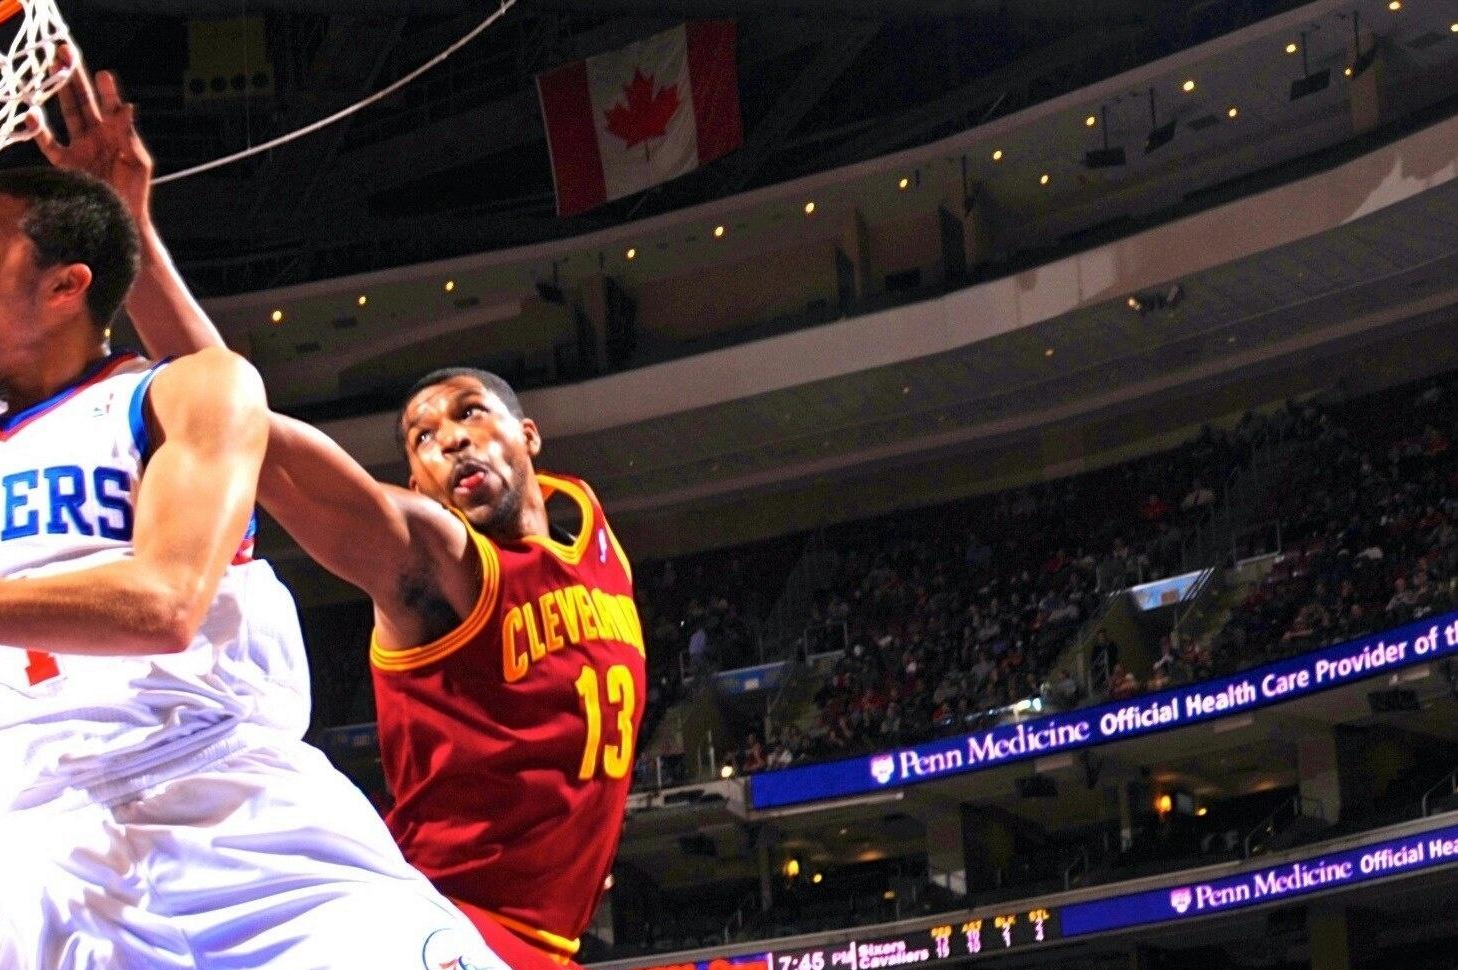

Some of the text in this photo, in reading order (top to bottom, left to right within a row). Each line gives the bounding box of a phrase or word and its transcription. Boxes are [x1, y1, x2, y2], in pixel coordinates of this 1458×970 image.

[575, 664, 636, 781] 13
[900, 749, 963, 779] Penn
[968, 721, 1090, 766] Medicine
[1100, 697, 1180, 737] Official
[1185, 680, 1257, 718] Health
[1262, 669, 1310, 698] Care
[1315, 641, 1408, 684] Provider
[1414, 625, 1440, 656] of
[1195, 882, 1251, 910] Penn
[1253, 861, 1353, 899] Medicine
[1359, 841, 1425, 874] Official
[859, 949, 930, 970] Cavaliers
